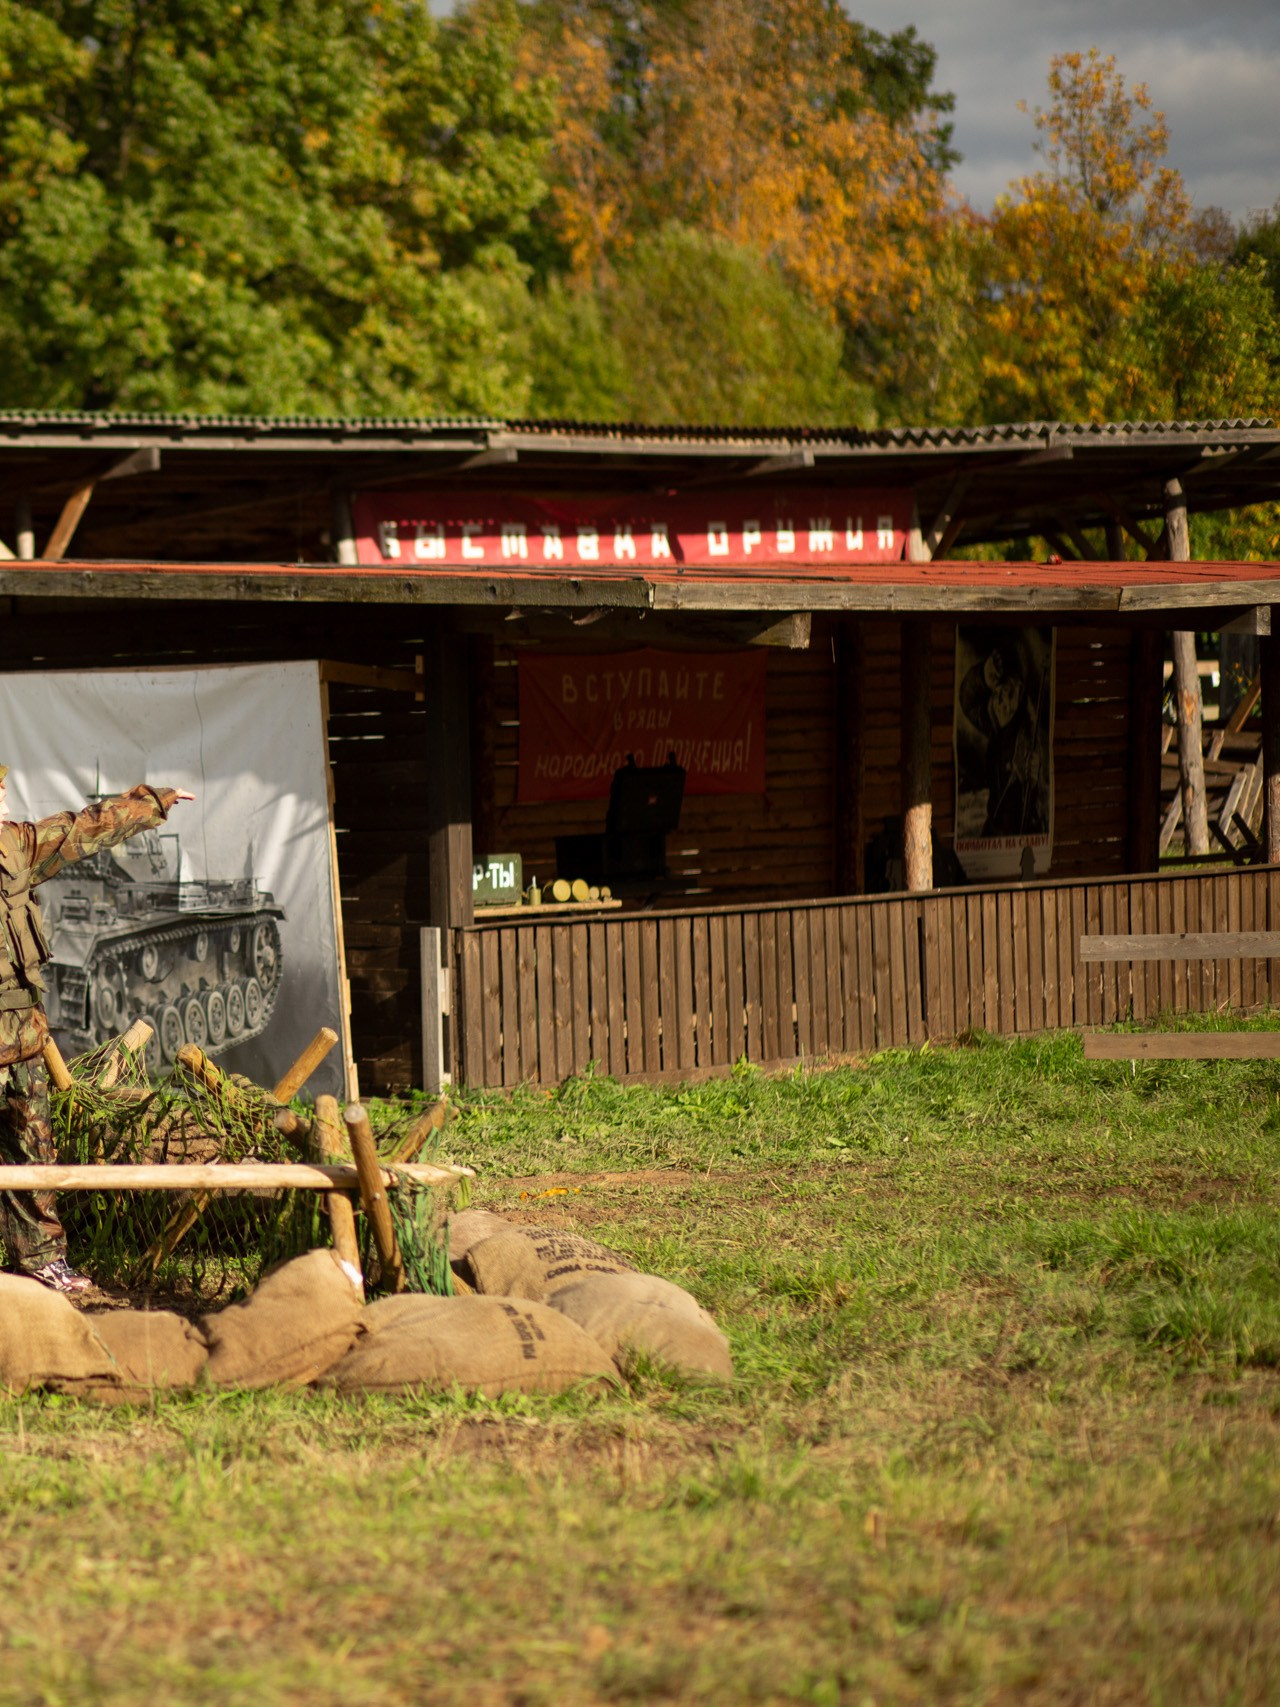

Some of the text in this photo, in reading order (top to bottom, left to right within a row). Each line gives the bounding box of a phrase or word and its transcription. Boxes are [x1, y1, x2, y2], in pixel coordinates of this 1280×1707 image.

[379, 515, 894, 560] ВЫСТАВКА ОРУЖИЯ
[561, 665, 726, 704] ВСТУПАЙТЕ
[626, 709, 672, 731] РЯДЫ
